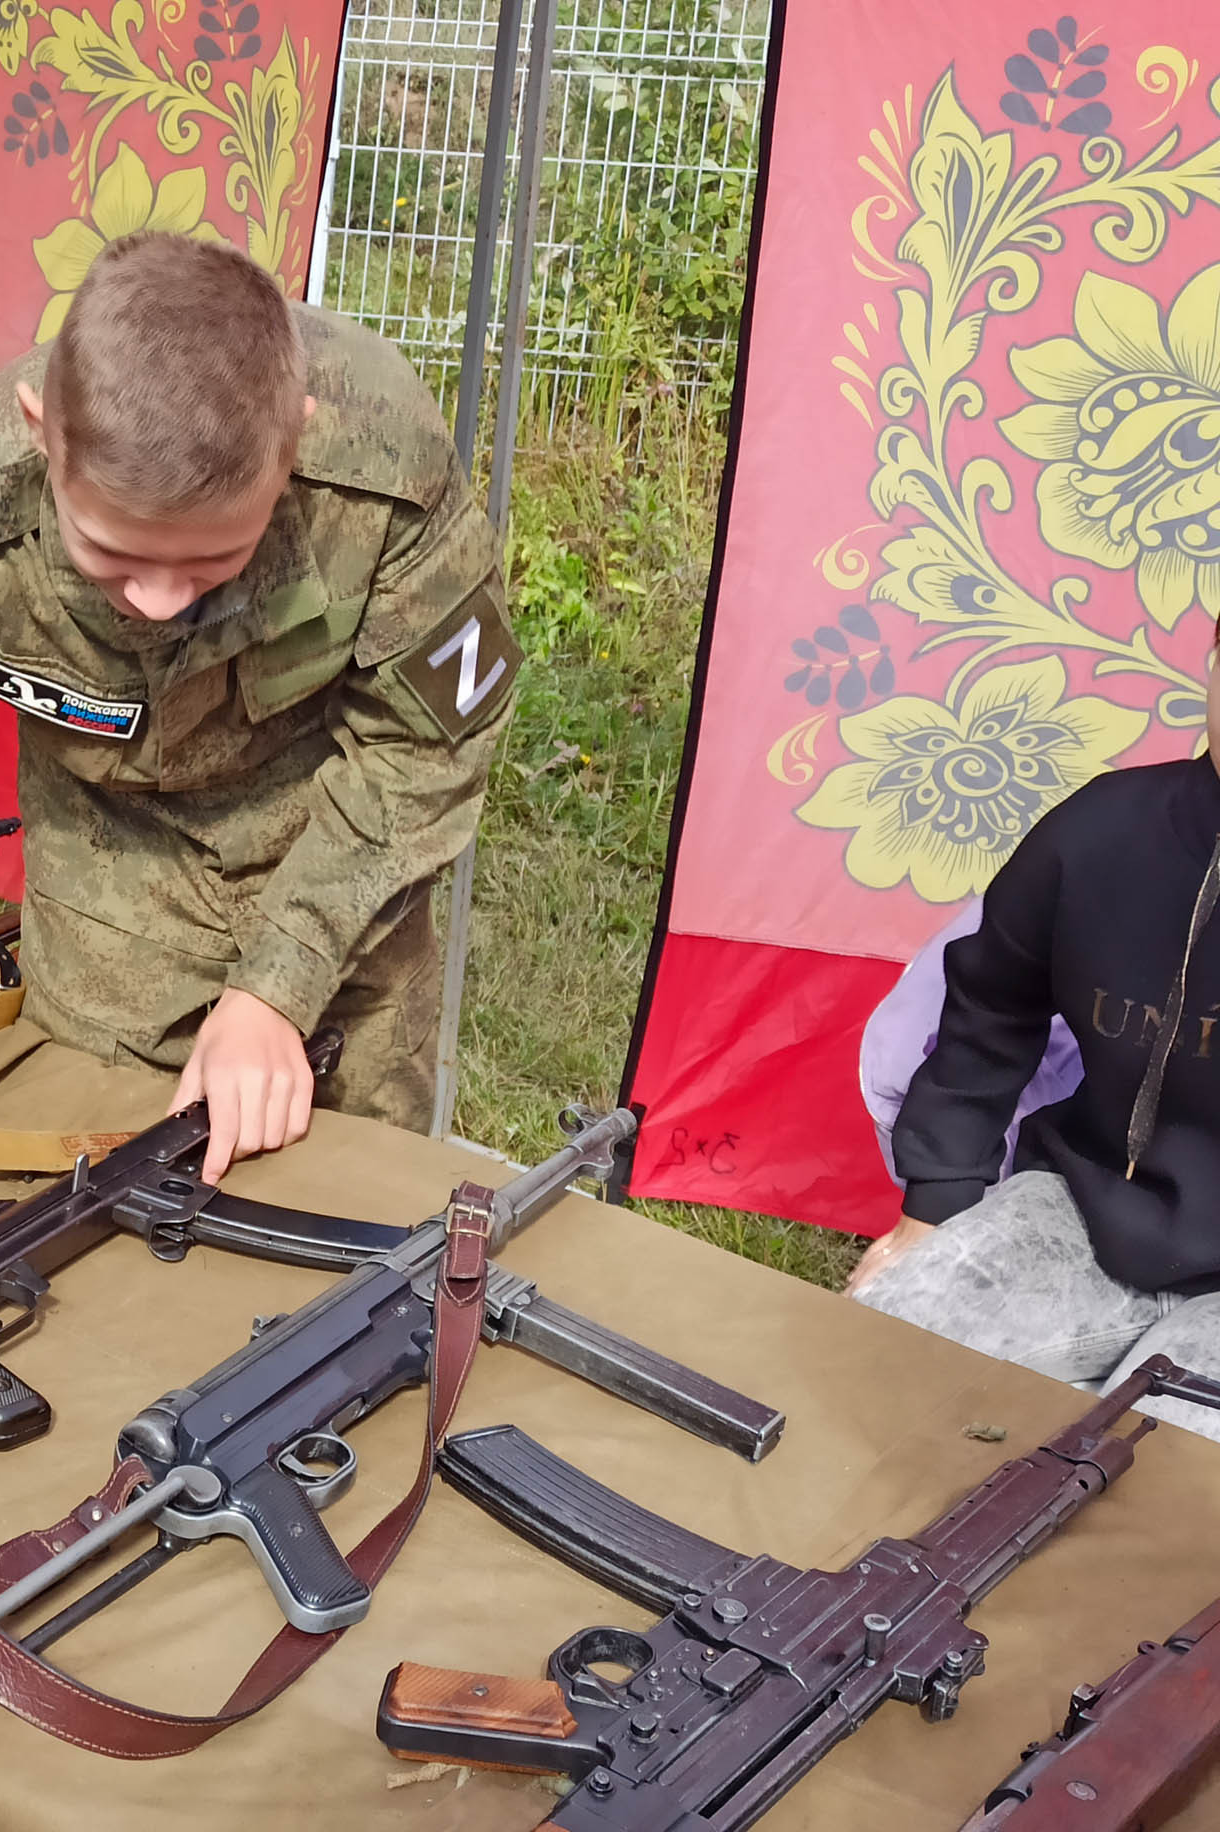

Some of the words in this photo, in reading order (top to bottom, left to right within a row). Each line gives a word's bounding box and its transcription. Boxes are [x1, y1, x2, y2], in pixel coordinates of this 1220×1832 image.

[427, 615, 507, 717] Z
[61, 694, 135, 718] ПОИСКОВОЕ
[61, 704, 128, 726] ДВИЖЕНИЕ
[67, 715, 117, 732] РОССИИ
